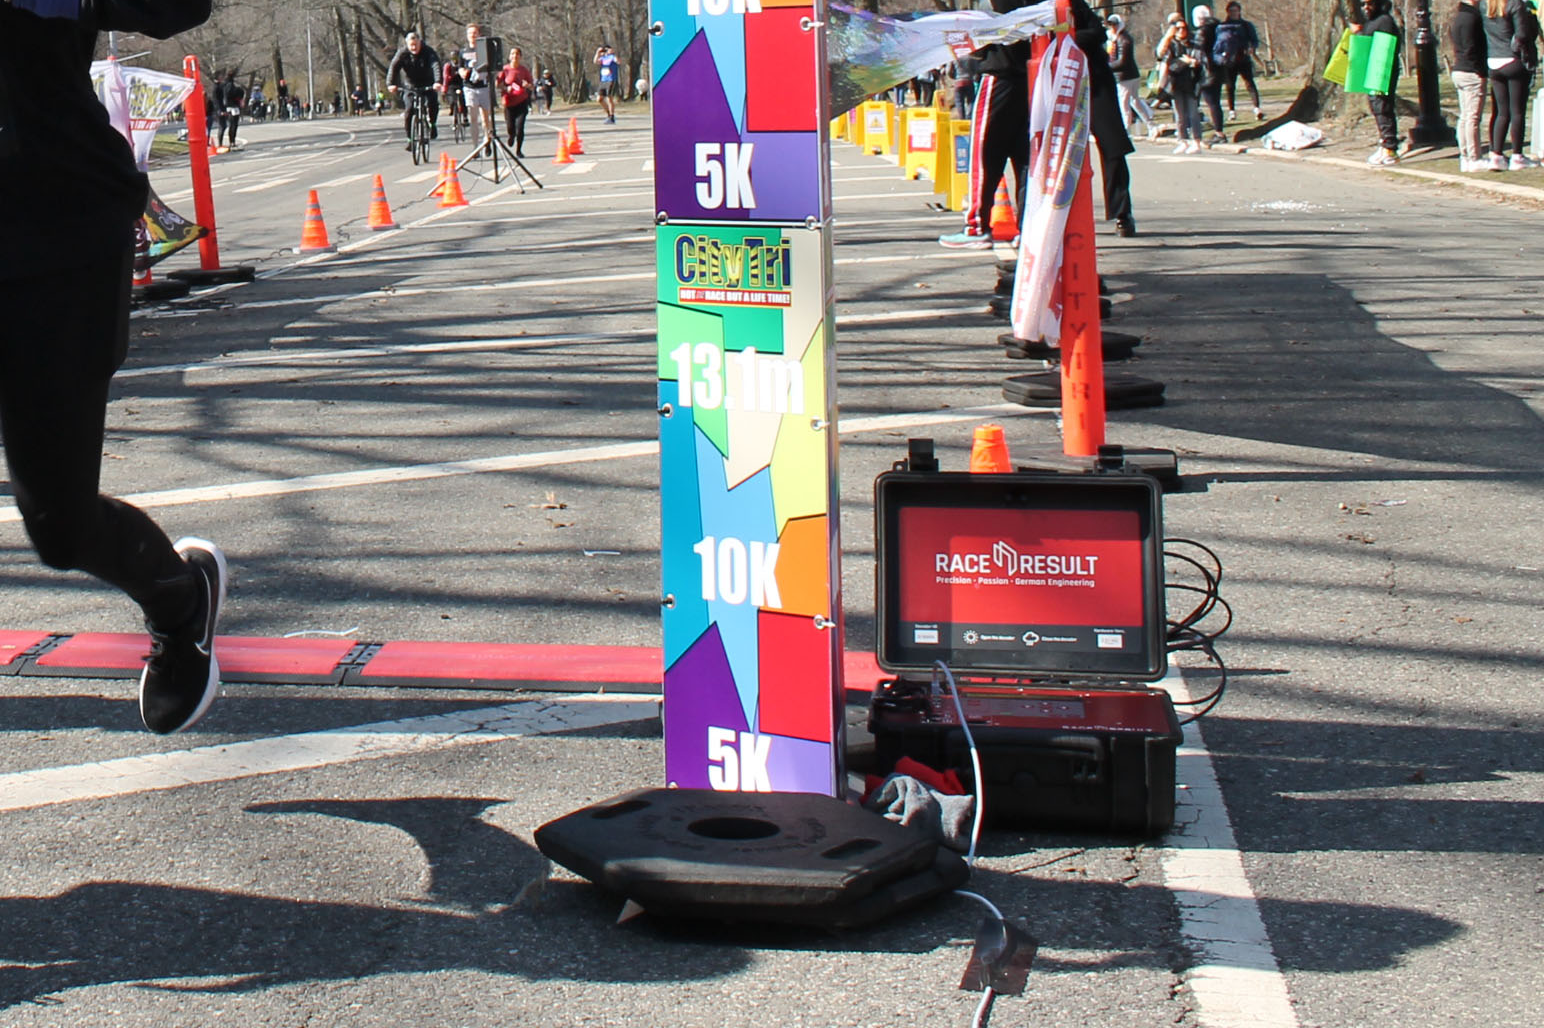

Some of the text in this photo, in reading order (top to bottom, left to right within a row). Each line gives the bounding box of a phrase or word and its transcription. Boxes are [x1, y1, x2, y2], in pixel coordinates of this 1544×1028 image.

[694, 142, 756, 210] 5K
[674, 234, 792, 289] CityTri
[669, 341, 804, 414] 13.1m
[693, 535, 782, 609] 10K
[935, 553, 1098, 576] RACE RESULT
[936, 576, 1096, 588] Precision Passion German Engineering
[707, 725, 773, 792] 5K
